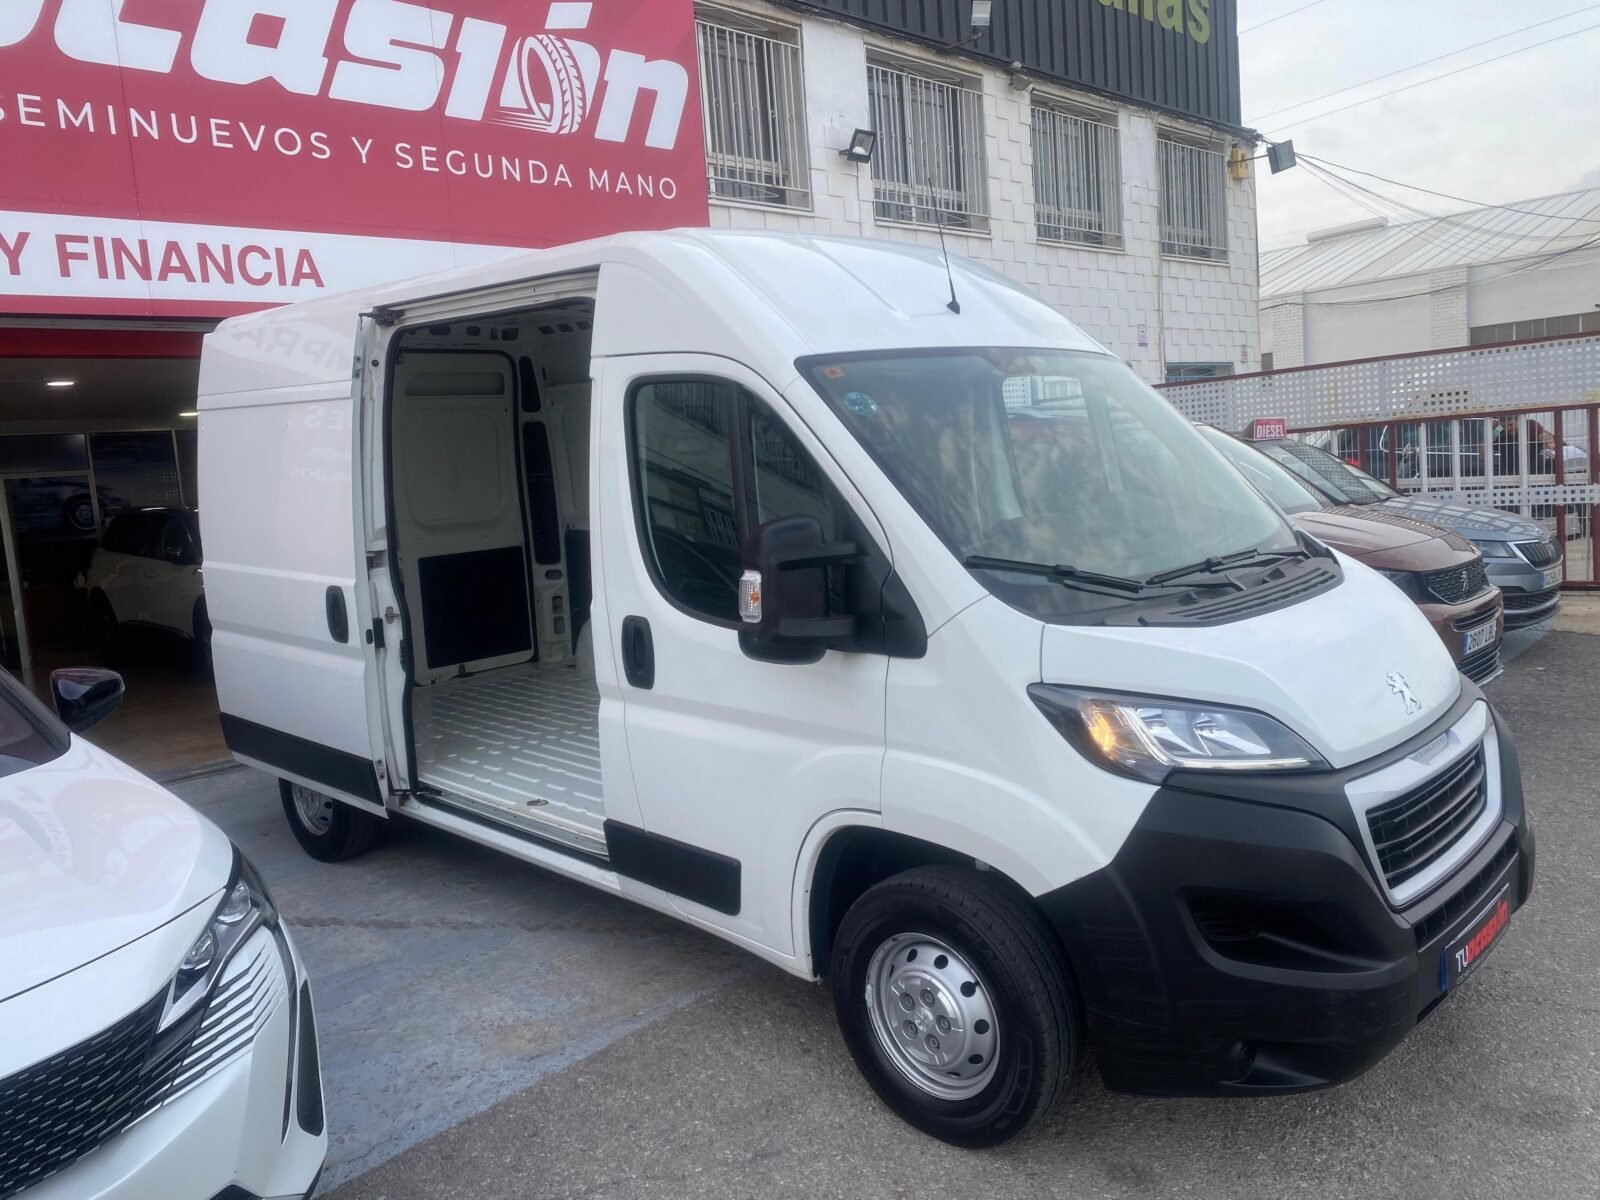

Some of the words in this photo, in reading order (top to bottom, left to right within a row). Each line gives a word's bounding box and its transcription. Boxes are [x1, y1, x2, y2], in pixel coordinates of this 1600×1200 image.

[0, 0, 689, 150] casión
[0, 93, 331, 160] EMINUEVOS
[351, 136, 373, 164] Y
[394, 142, 573, 188] SEGUNDA
[588, 167, 677, 200] MANO
[54, 233, 326, 288] FINANCIA
[1256, 424, 1285, 439] DIESEL
